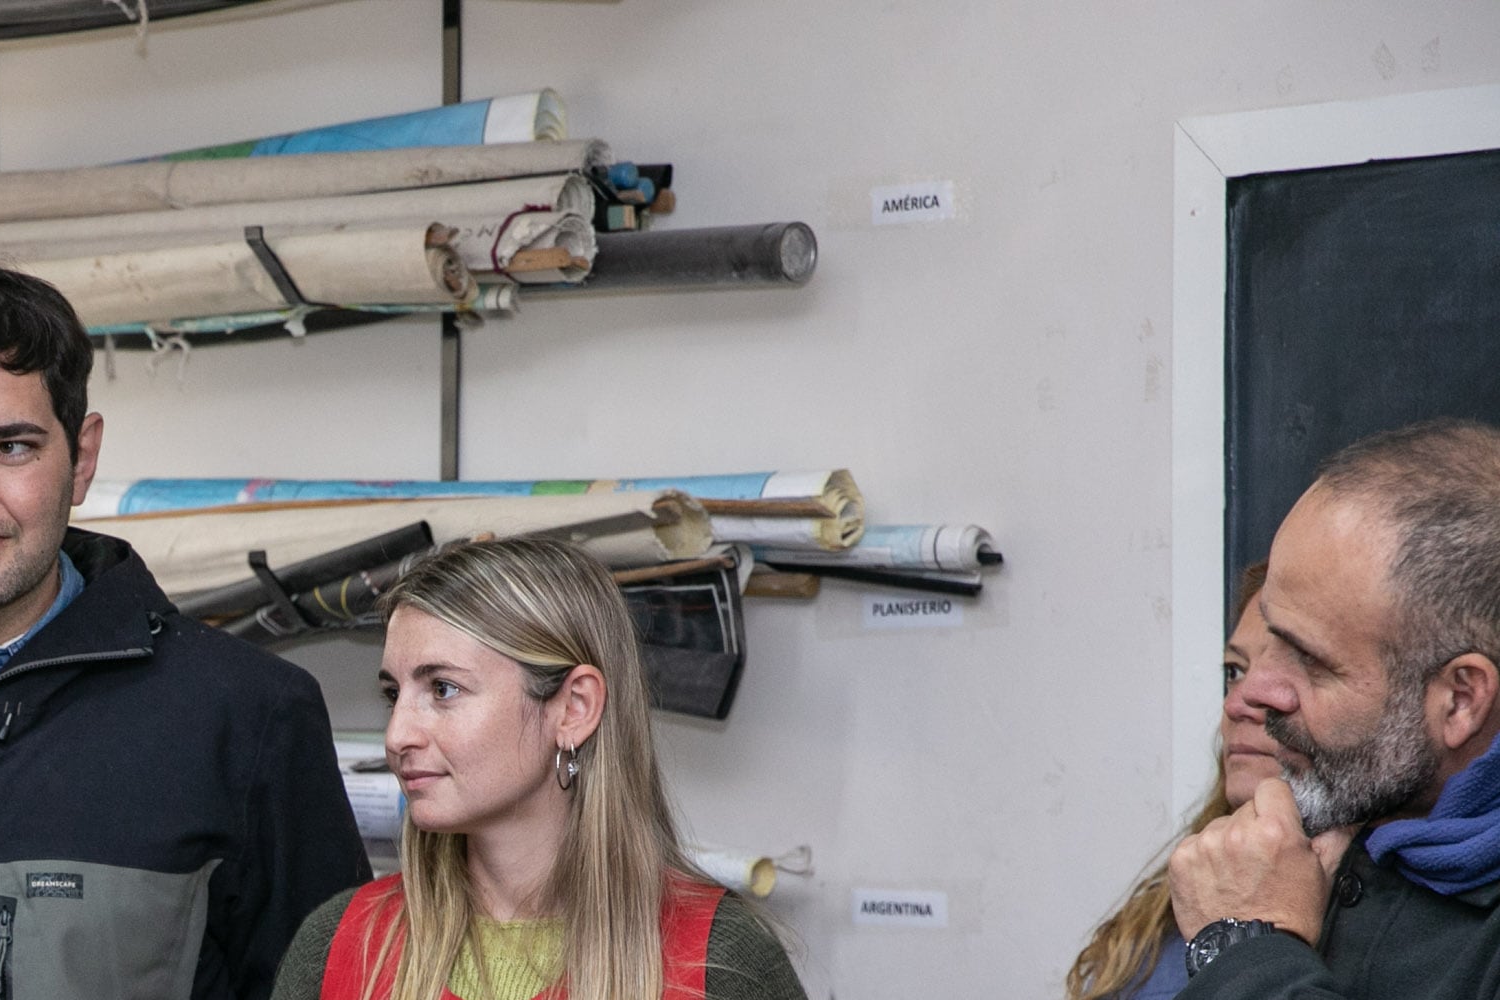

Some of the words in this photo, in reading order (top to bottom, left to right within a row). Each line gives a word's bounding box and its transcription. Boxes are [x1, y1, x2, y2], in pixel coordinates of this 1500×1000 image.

[882, 194, 940, 213] AMÉRICA
[872, 599, 951, 616] PLANISFERIO
[861, 901, 933, 916] ARGENTINA
